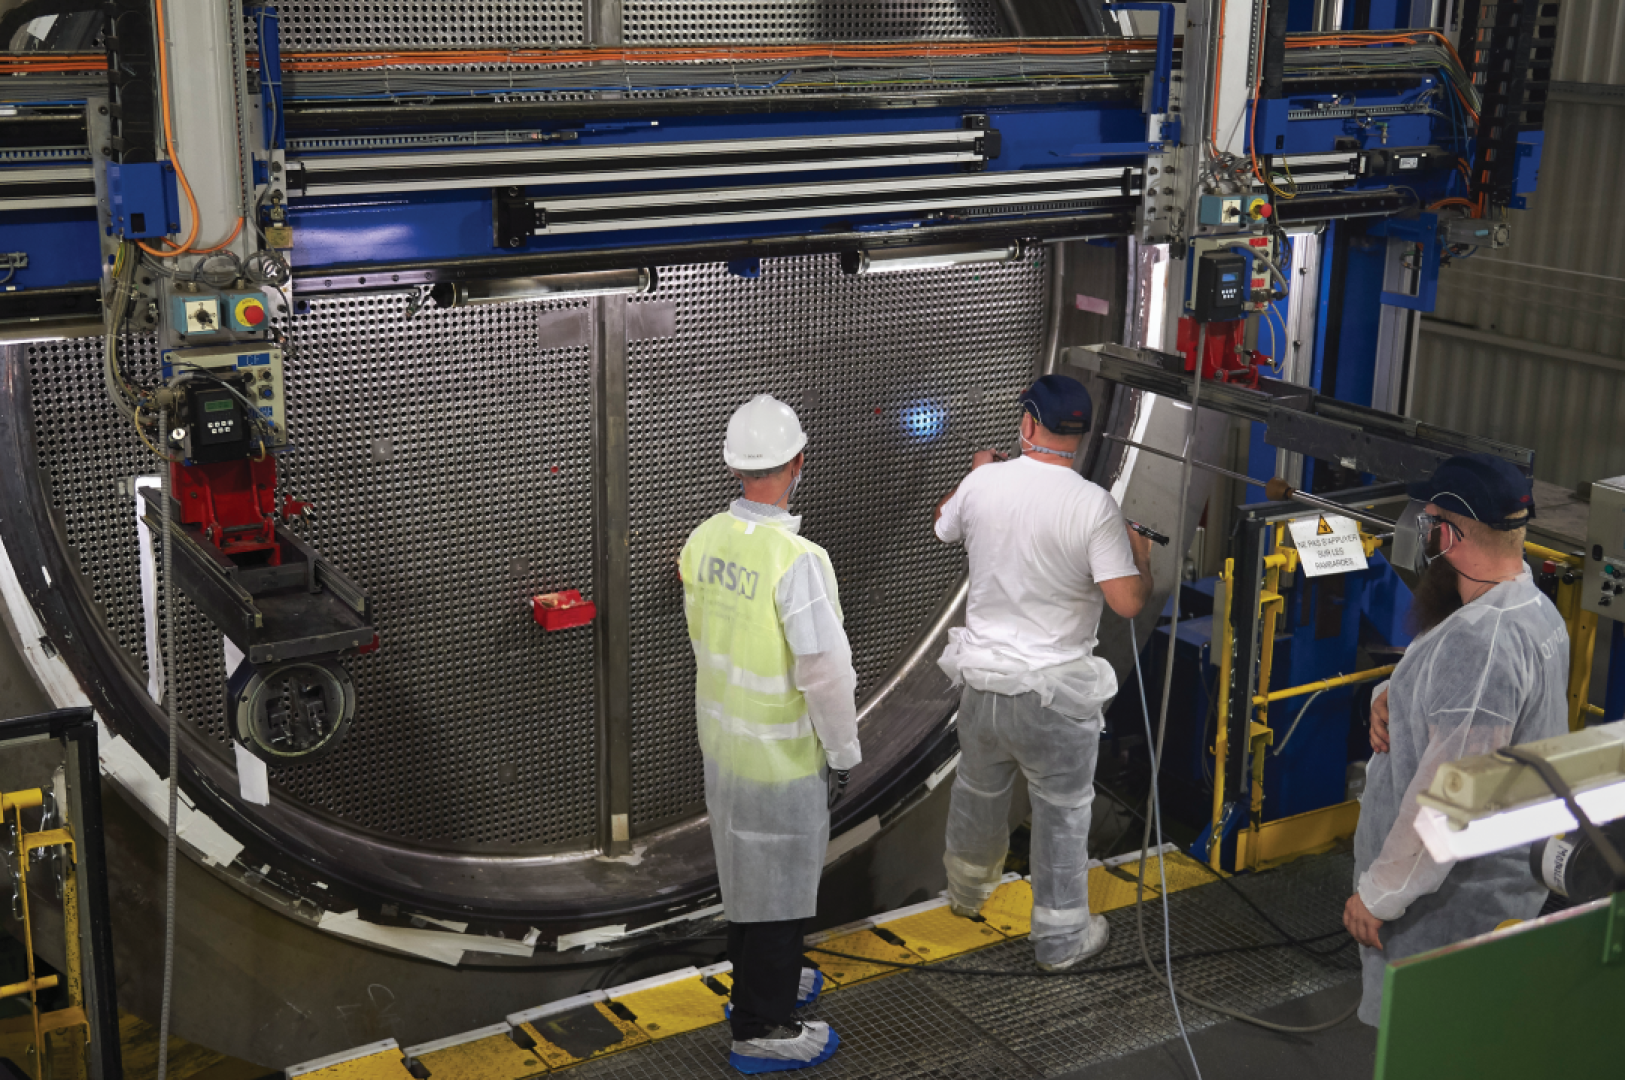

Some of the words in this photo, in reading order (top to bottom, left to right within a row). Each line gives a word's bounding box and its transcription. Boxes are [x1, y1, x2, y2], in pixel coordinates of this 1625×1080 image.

[1307, 539, 1321, 548] PAS
[1317, 549, 1332, 558] SUR
[1332, 547, 1344, 556] LES
